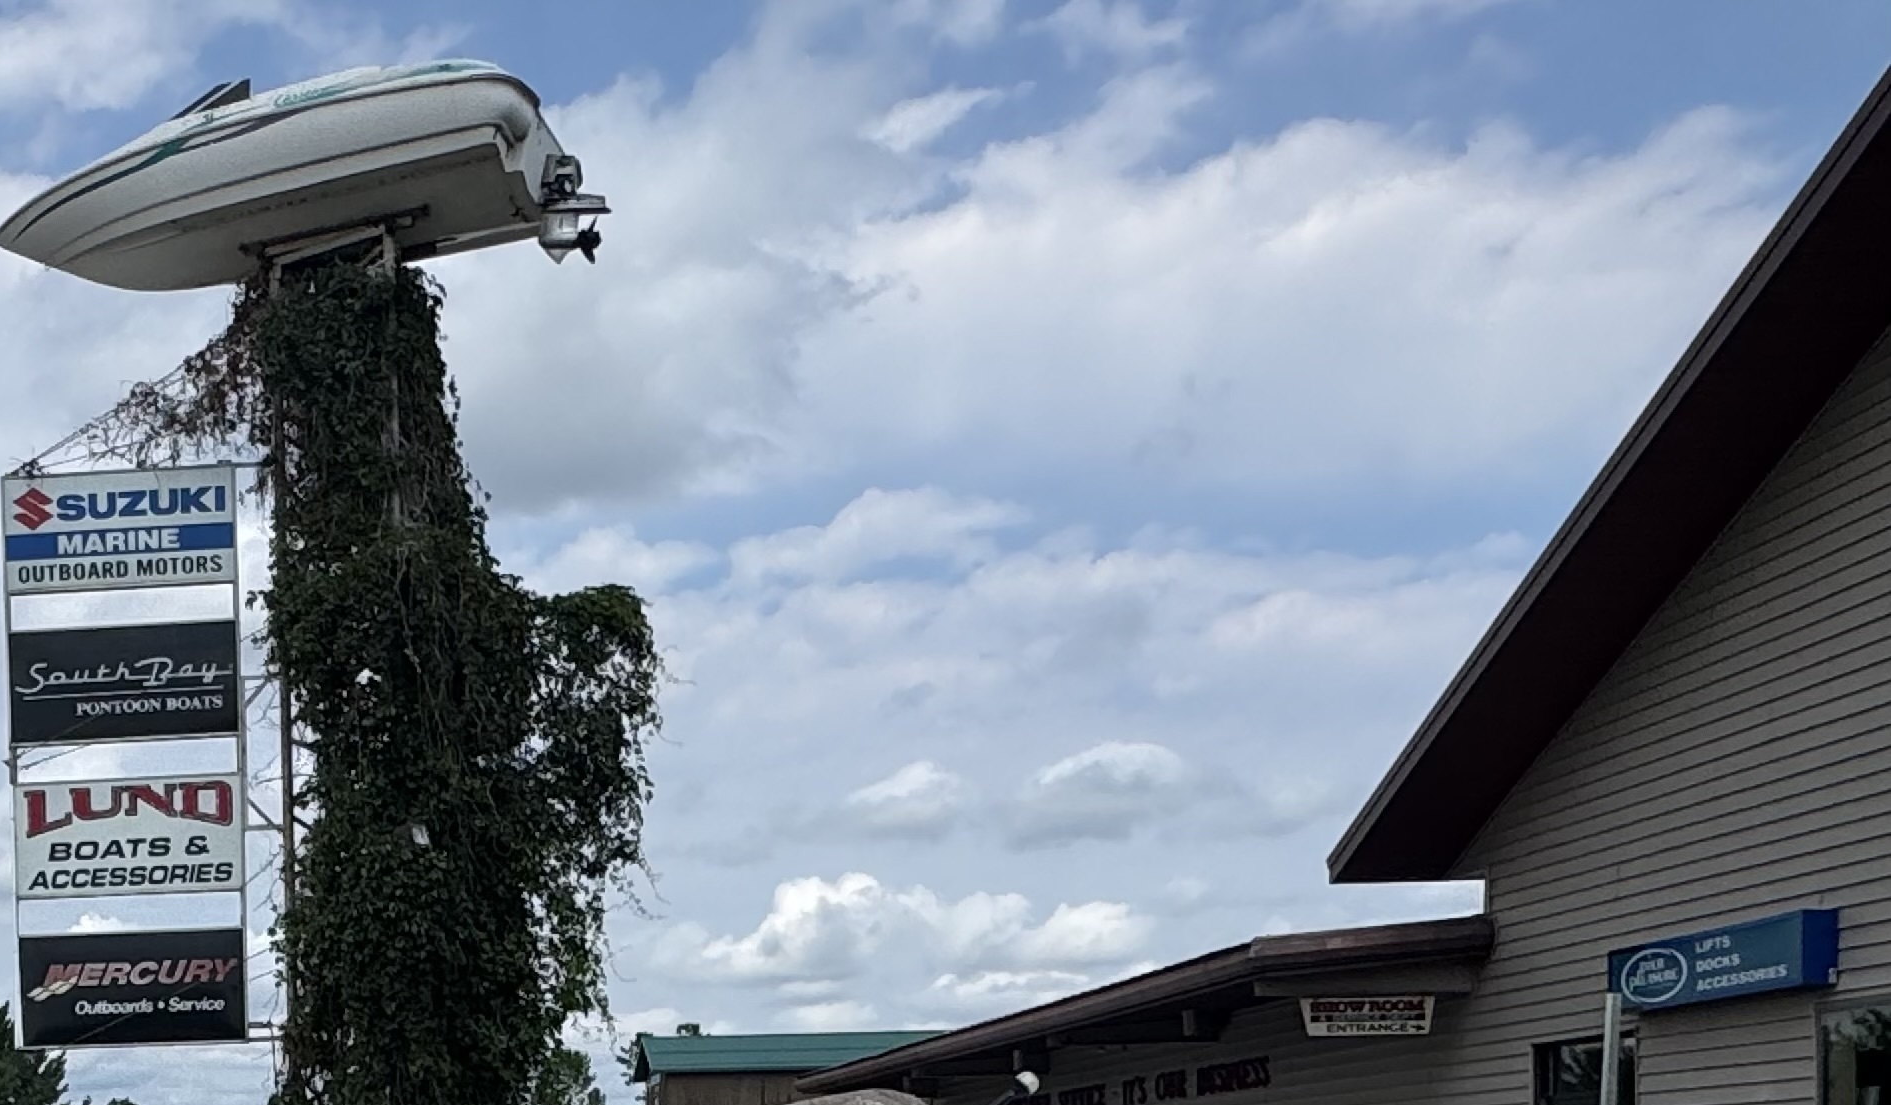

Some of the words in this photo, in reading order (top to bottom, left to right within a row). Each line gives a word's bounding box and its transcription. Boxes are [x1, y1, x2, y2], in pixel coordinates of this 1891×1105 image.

[56, 486, 226, 521] SUZUKI
[57, 528, 181, 555] MARINE
[18, 559, 128, 584] OUTBOARD
[136, 555, 223, 577] MOTORS
[76, 698, 161, 717] PONTOON
[166, 694, 224, 711] BOATS
[23, 780, 234, 839] LUND
[48, 837, 171, 862] BOATS
[184, 835, 210, 856] &
[28, 862, 234, 890] ACCESSORIES
[1694, 935, 1731, 954] LIFTS
[43, 958, 238, 987] MERCURY
[1695, 953, 1740, 973] DOCKS
[1696, 963, 1788, 992] ACCESSORIES
[74, 998, 154, 1015] Outboards
[168, 996, 226, 1012] Service
[1326, 1022, 1409, 1033] ENTRANCE
